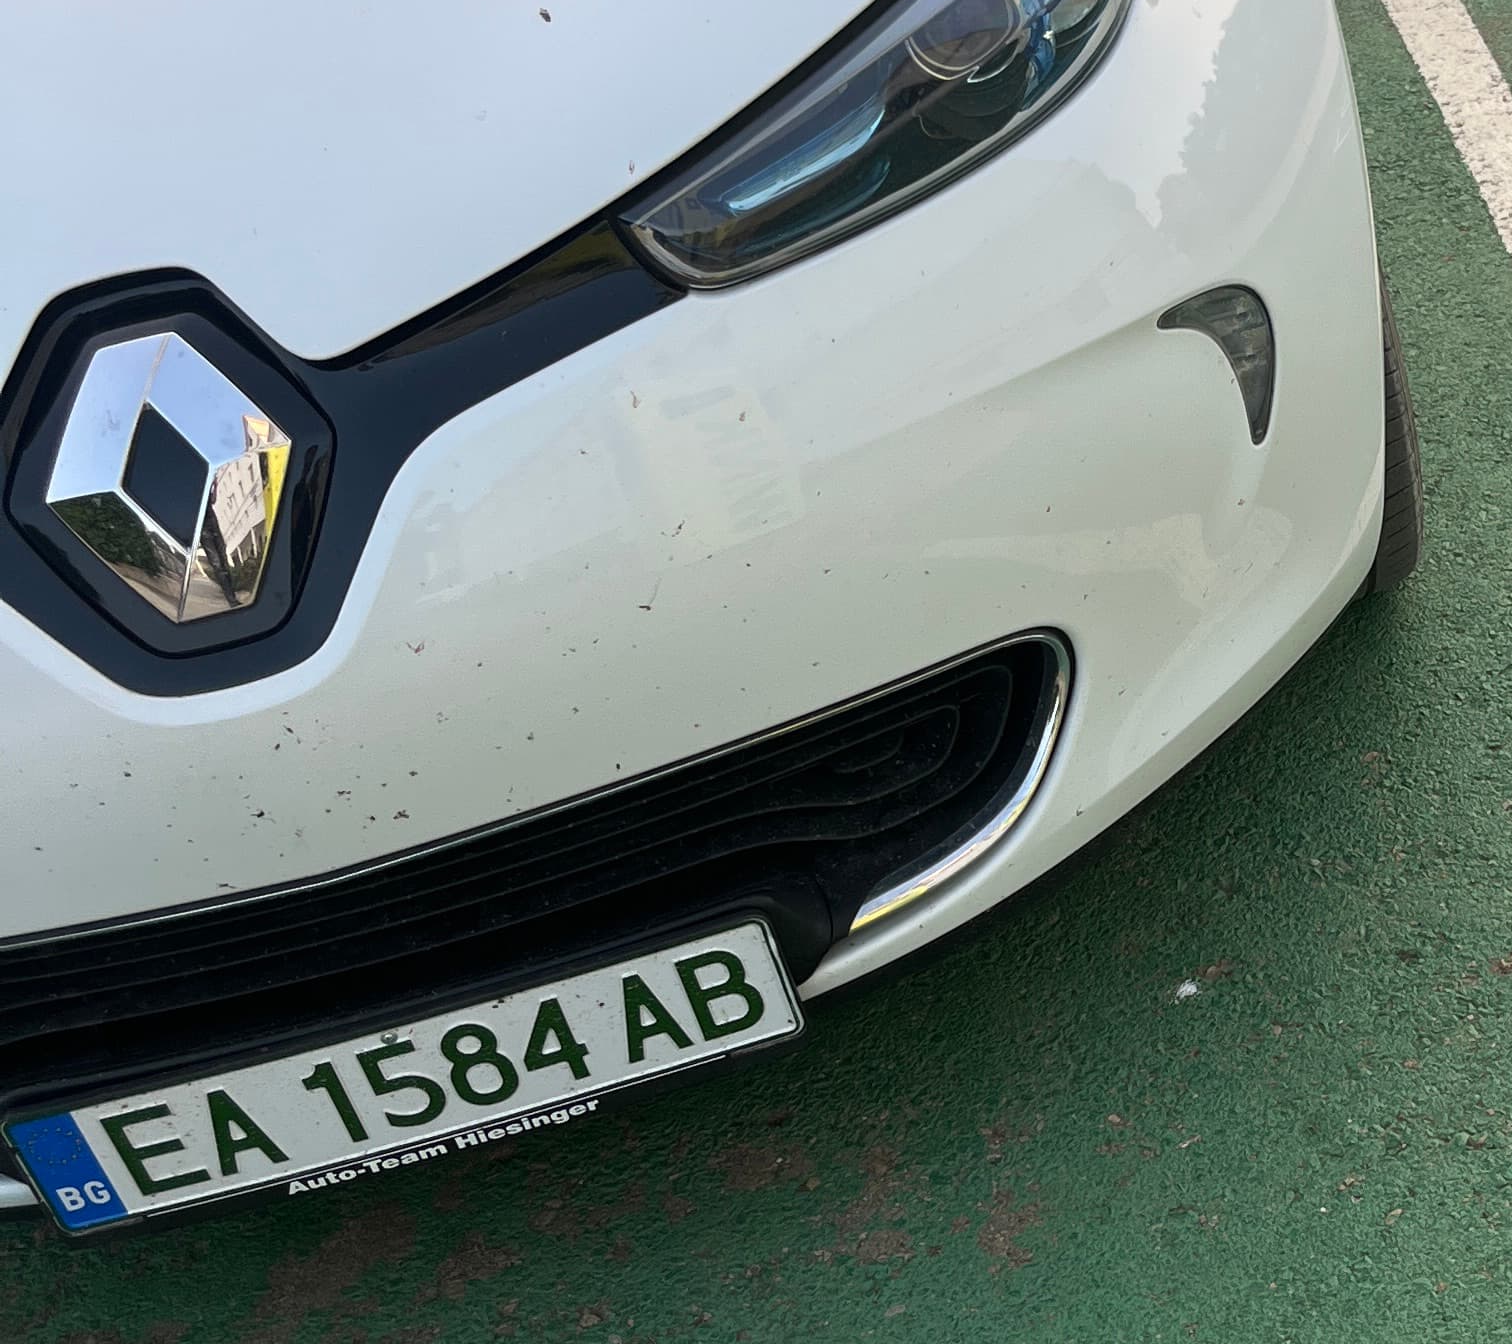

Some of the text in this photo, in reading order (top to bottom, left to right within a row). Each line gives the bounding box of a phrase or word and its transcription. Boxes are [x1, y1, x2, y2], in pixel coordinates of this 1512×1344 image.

[99, 948, 765, 1196] EA 1584 AB
[55, 1179, 113, 1213] BG
[286, 1097, 600, 1196] Auto-Team Hiesinger
